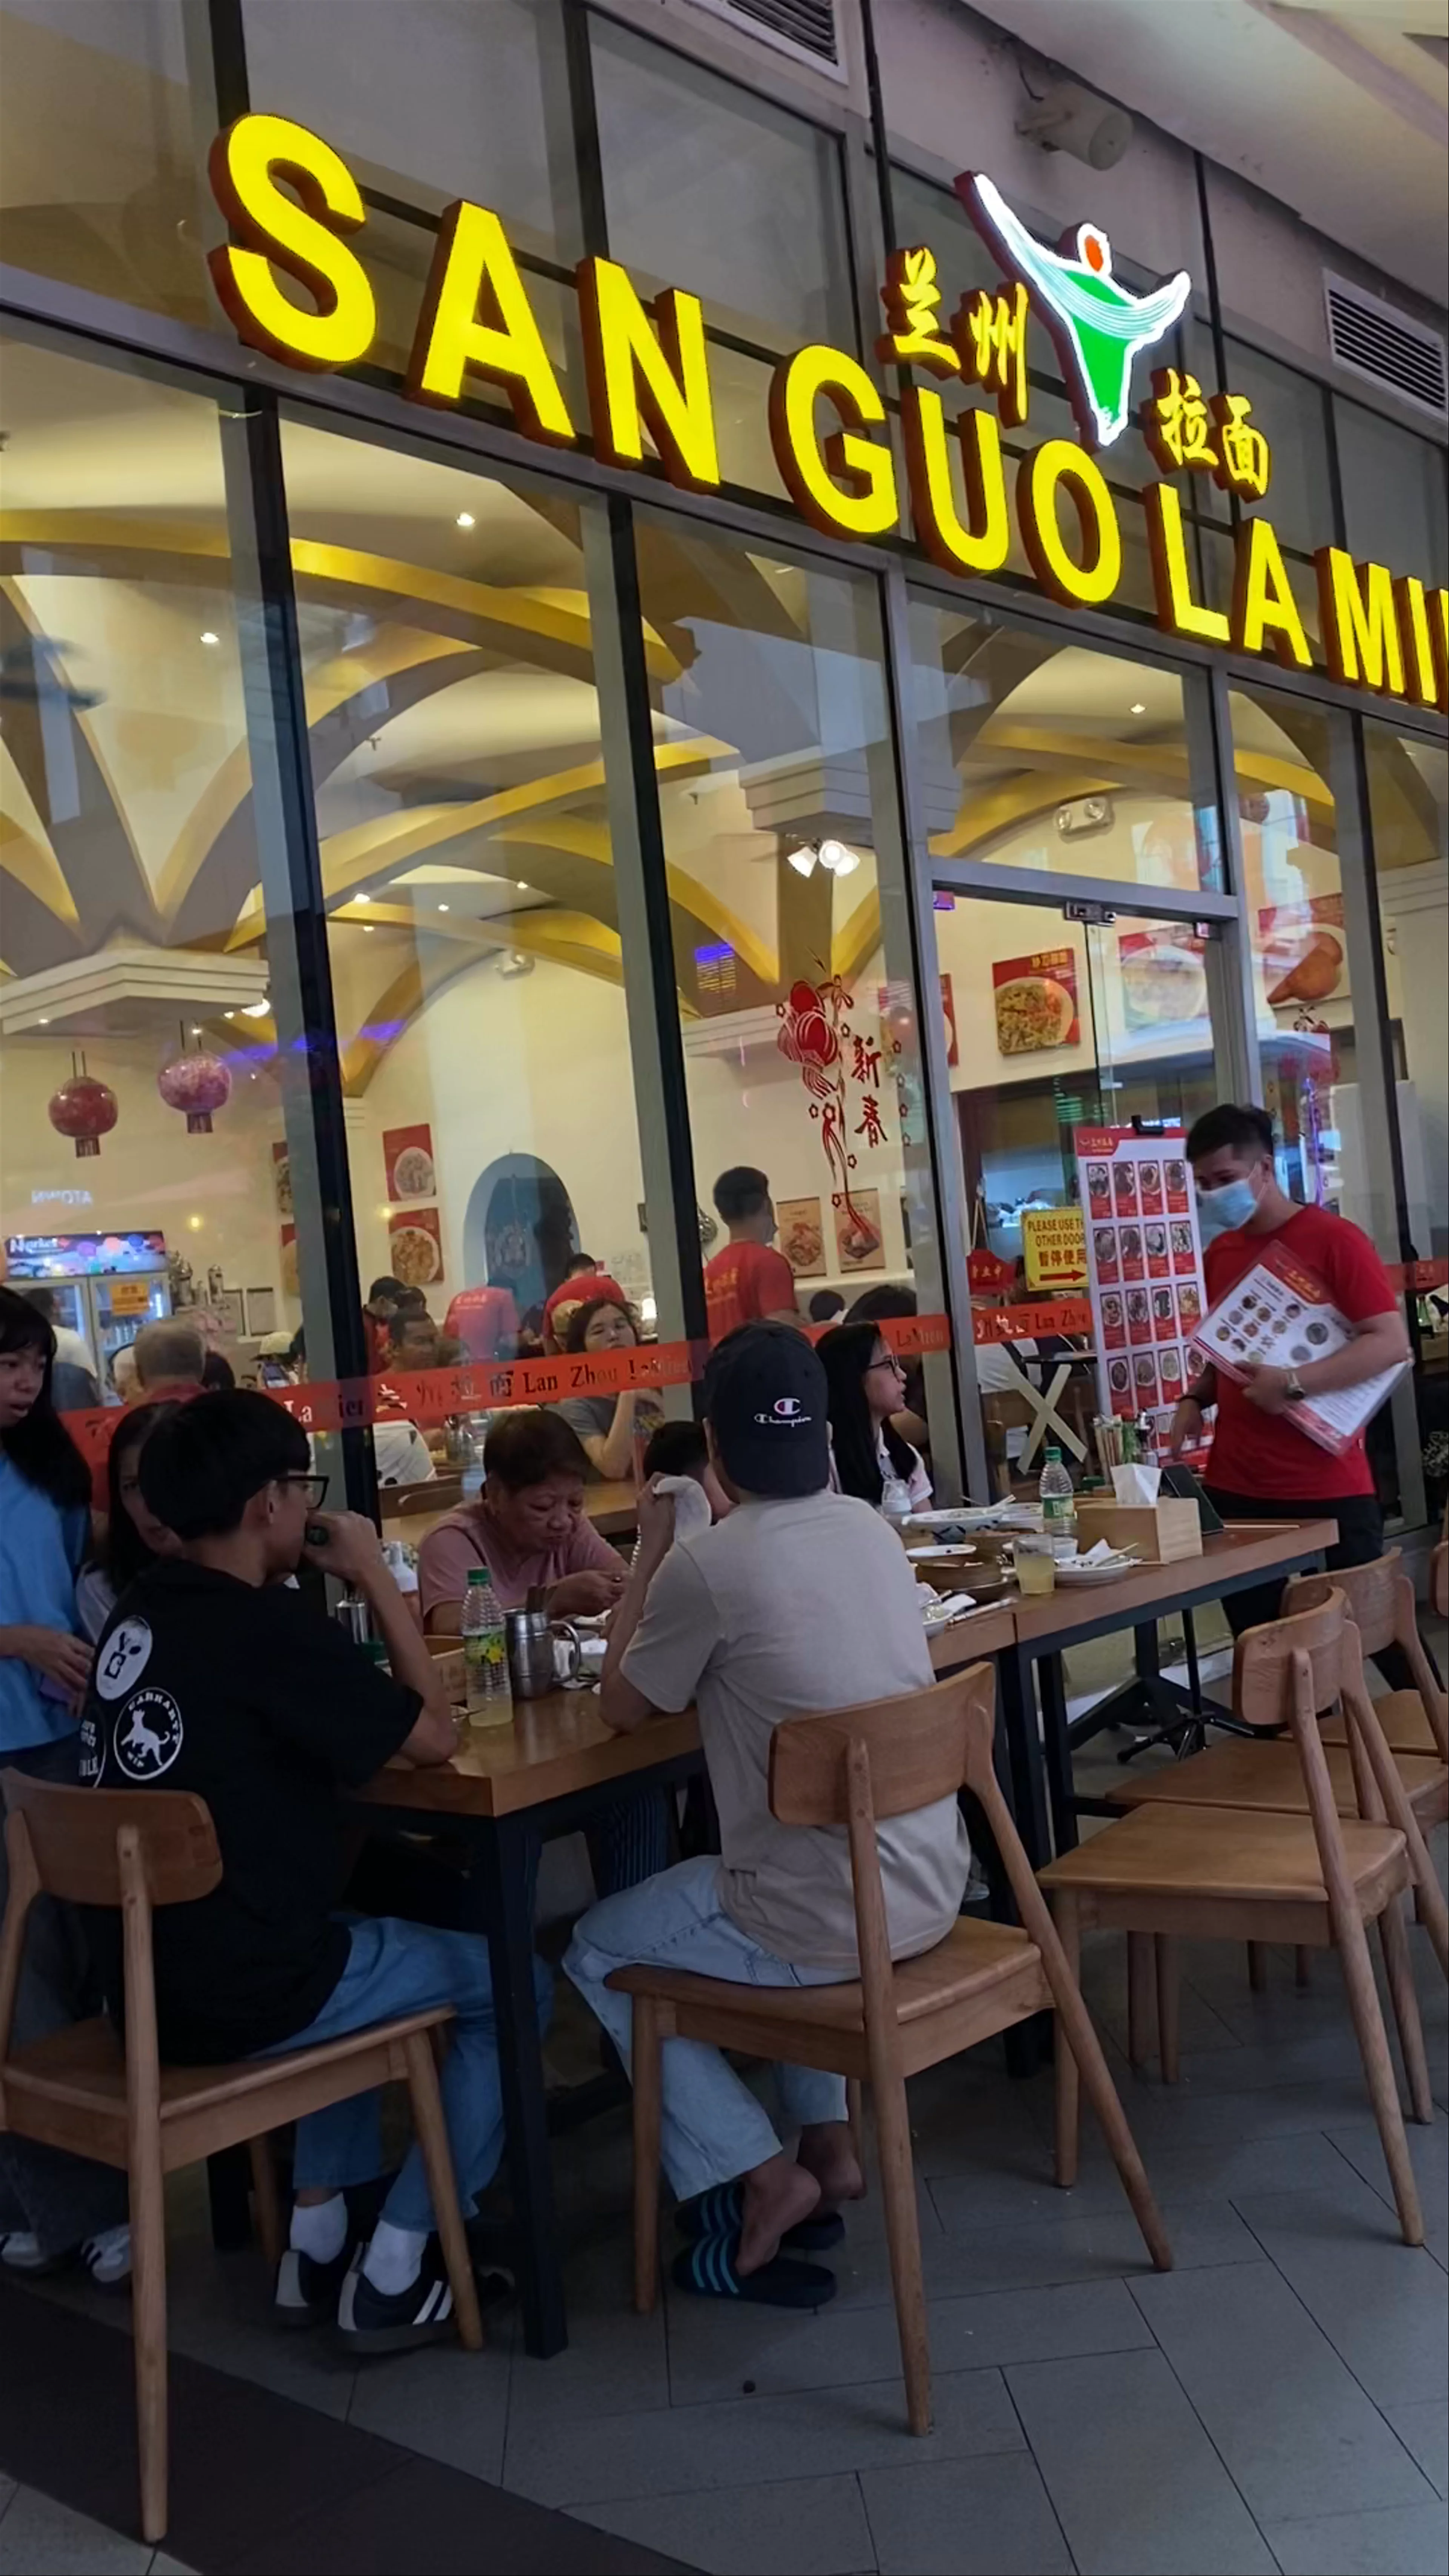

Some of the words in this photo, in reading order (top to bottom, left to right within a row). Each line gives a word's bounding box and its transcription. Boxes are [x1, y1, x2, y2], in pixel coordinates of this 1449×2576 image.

[892, 247, 1029, 422] 兰州
[1156, 367, 1269, 496] 拉面
[223, 112, 721, 486] SAN
[780, 343, 1121, 604] GUO
[1158, 483, 1449, 704] LAMI
[851, 1035, 888, 1148] 新春
[1028, 1219, 1057, 1232] PLEASE
[1058, 1218, 1074, 1230] USE
[1035, 1233, 1062, 1247] OTHER
[522, 1372, 558, 1393] Lan
